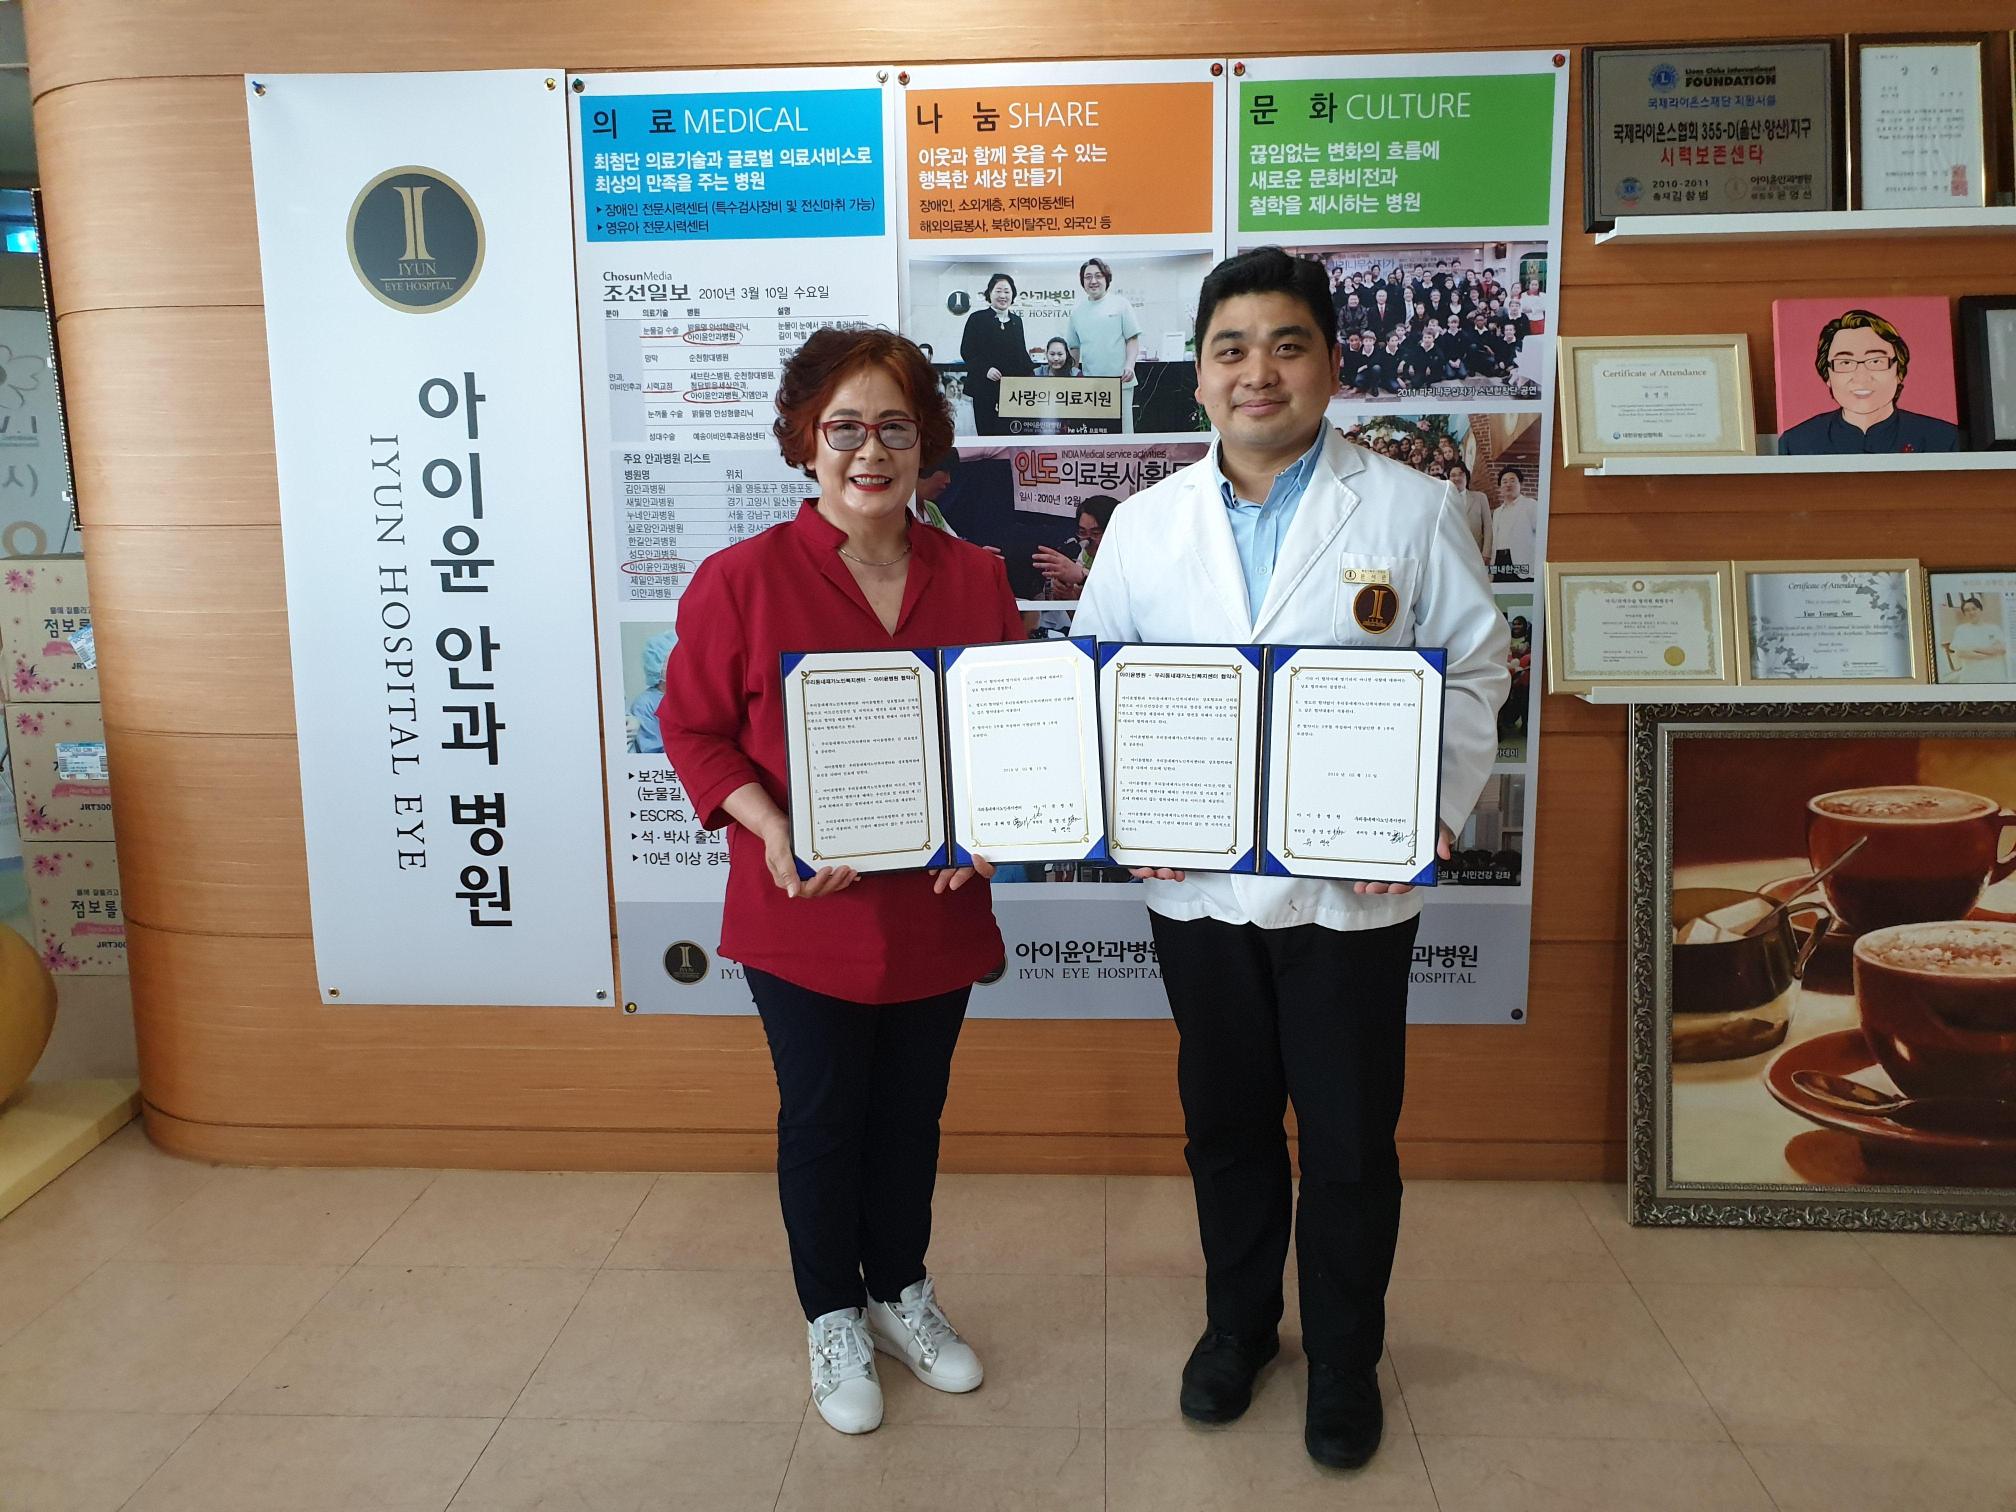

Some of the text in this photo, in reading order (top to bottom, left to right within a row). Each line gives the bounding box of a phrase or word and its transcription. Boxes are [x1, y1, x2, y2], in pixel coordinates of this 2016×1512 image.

[1685, 75, 1776, 87] FOUNDATION
[1346, 93, 1471, 120] CULTURE
[684, 107, 808, 135] MEDICAL
[1009, 101, 1099, 128] SHARE
[1614, 122, 1698, 143] 국제라이온스협회
[919, 143, 1108, 167] 이웃과 함께 웃을 수 있는
[1250, 141, 1440, 164] 끊임없는 변화의 흐름에
[594, 147, 873, 172] 최첨단 의료기술과 글로벌 의료서비스로
[595, 172, 765, 194] 최상의 만족을 주는 병원
[919, 167, 1062, 189] 행복한 세상 만들기
[1250, 168, 1398, 190] 새로운 문화비전과
[605, 197, 876, 217] 장애인 전문시력센터 (특수검사장비 및 전신마취 가능)
[920, 196, 1074, 213] 장애인, 소외계층, 지역아동센터
[1250, 192, 1421, 216] 철학을 제시하는 병원
[606, 220, 709, 235] 영유아 전문시력센터
[920, 216, 1111, 233] 해외의료봉사, 북한이탈주민, 외국인 등
[399, 263, 437, 276] IYUN
[603, 271, 672, 282] ChosunMedia
[385, 281, 453, 292] EYE HOSPITAL
[603, 284, 830, 302] 조선일보 2010년 3월 10일 수요일
[687, 308, 700, 317] 병원
[778, 307, 791, 316] 설명
[688, 332, 736, 341] 아이윤안과병원
[1603, 369, 1646, 378] Certificate
[1659, 369, 1707, 377] Attendance
[610, 383, 641, 391] 이비인후과
[647, 382, 673, 390] 시력교정
[1009, 391, 1112, 408] 사랑의 의료지원
[649, 432, 675, 441] 성대수술
[624, 454, 711, 464] 주요 안과병원 리스트
[1080, 451, 1104, 459] Medical
[1106, 450, 1132, 459] service
[1133, 450, 1166, 459] activities
[625, 469, 743, 480] 병원명 위치
[1015, 450, 1060, 486] 인도
[626, 484, 812, 494] 김안과병원 서울 영등포구 영등포동
[626, 498, 770, 507] 새빛안과병원 경기 고양시
[627, 511, 675, 520] 누네안과병원
[728, 511, 743, 520] 서울
[747, 511, 771, 520] 강남구
[628, 524, 744, 533] 실로암안과병원 서울
[628, 537, 676, 547] 한길안과병원
[630, 563, 686, 572] 아이윤안과병원
[630, 576, 678, 586] 제일안과병원
[1788, 582, 1821, 590] Certificate
[369, 434, 427, 871] IYUN HOSPITAL EYE
[418, 371, 513, 927] 아이윤 안과 병원
[638, 770, 680, 783] 보건복
[640, 810, 687, 823] ESCRS,
[643, 852, 670, 865] 10년
[675, 852, 701, 865] 이상
[1019, 968, 1054, 979] IYUN
[1063, 968, 1089, 979] EYE
